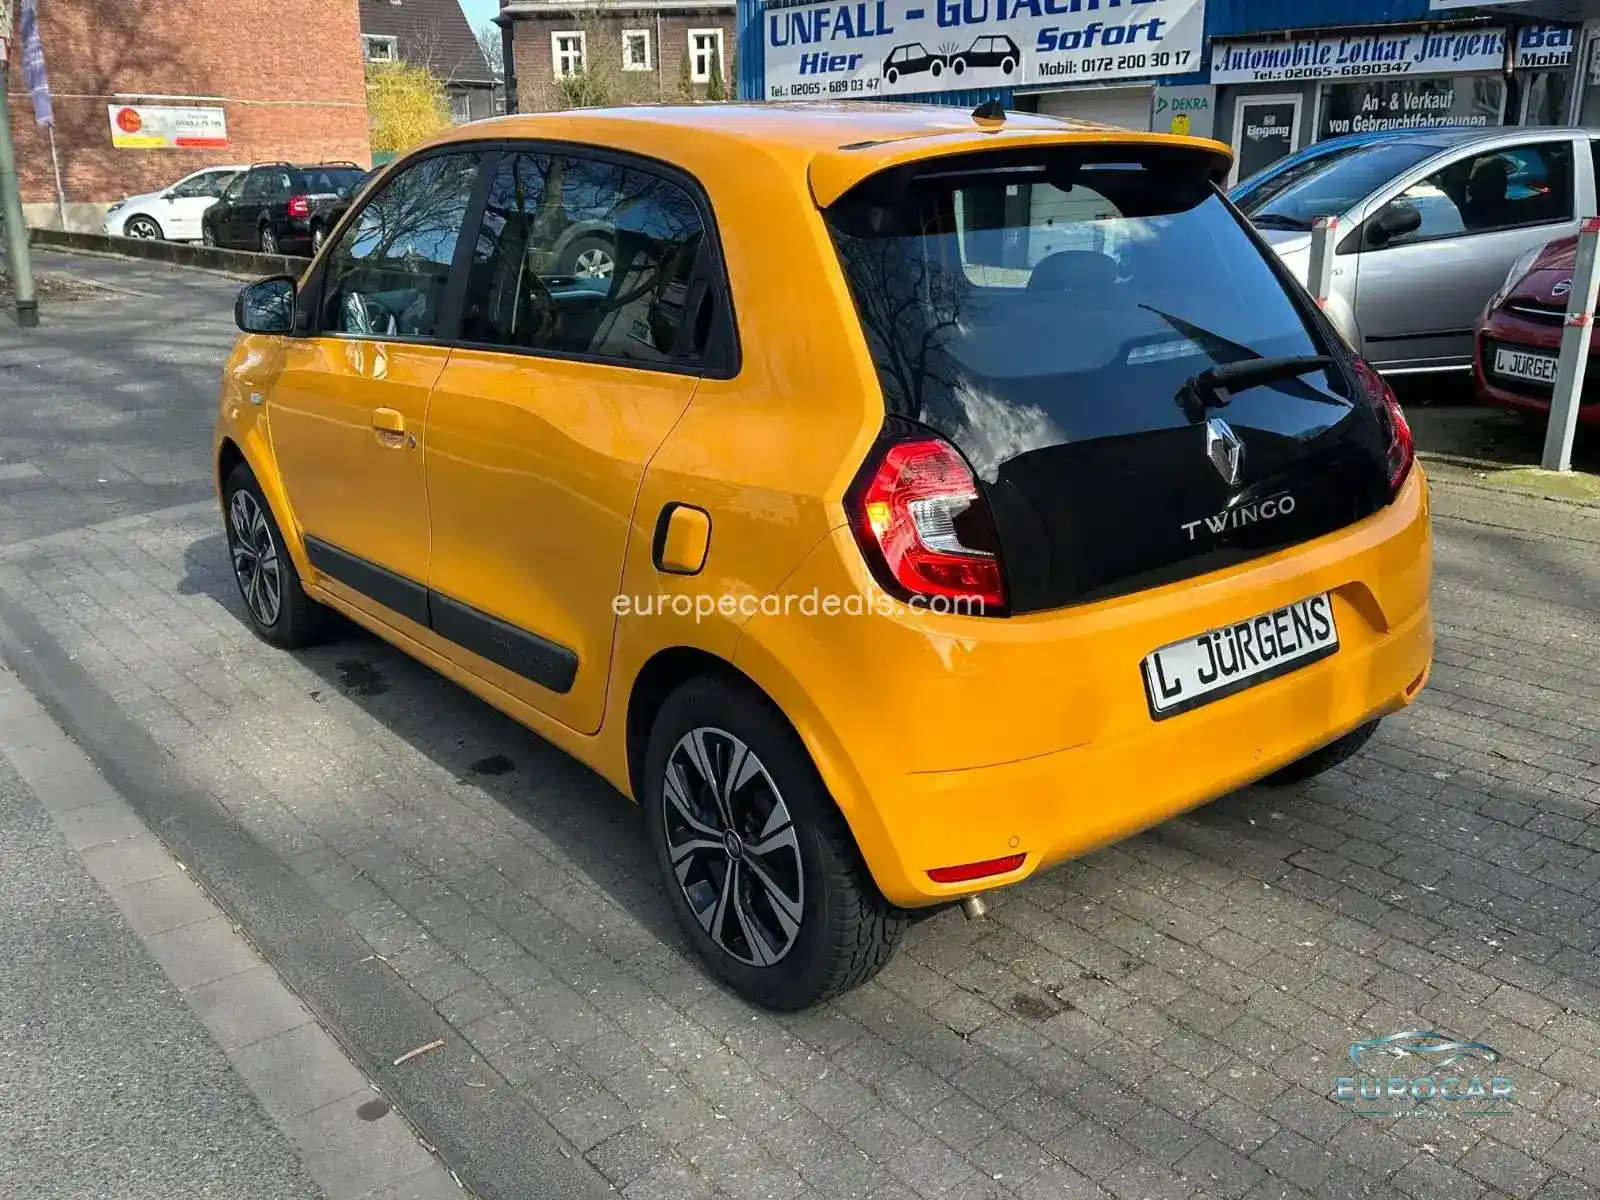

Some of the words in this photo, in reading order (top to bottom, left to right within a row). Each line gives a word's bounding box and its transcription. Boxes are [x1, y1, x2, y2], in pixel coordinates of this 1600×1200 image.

[770, 0, 894, 47] UNFALL
[1036, 17, 1166, 53] Sofort
[799, 51, 863, 76] Hier
[1038, 60, 1077, 77] Mobil:
[1081, 57, 1113, 74] 0172
[1117, 54, 1146, 71] 200
[1151, 53, 1169, 67] 30
[1175, 51, 1191, 66] 17
[1214, 39, 1331, 72] Automobile
[1336, 34, 1411, 64] Lothar
[770, 86, 789, 97] Tel.:
[791, 82, 820, 96] 02065
[829, 80, 848, 93] 689
[851, 79, 863, 91] 03
[866, 78, 880, 90] 47
[1253, 70, 1281, 80] Tel.:
[1171, 97, 1209, 111] DEKRA
[1362, 94, 1379, 112] An
[1403, 90, 1454, 111] Verkauf
[1246, 124, 1290, 138] Eingang
[1329, 119, 1349, 133] von
[1497, 351, 1505, 371] L
[1509, 354, 1560, 380] JÜRGEN
[1181, 496, 1296, 541] TWINGO
[1153, 652, 1182, 700] L
